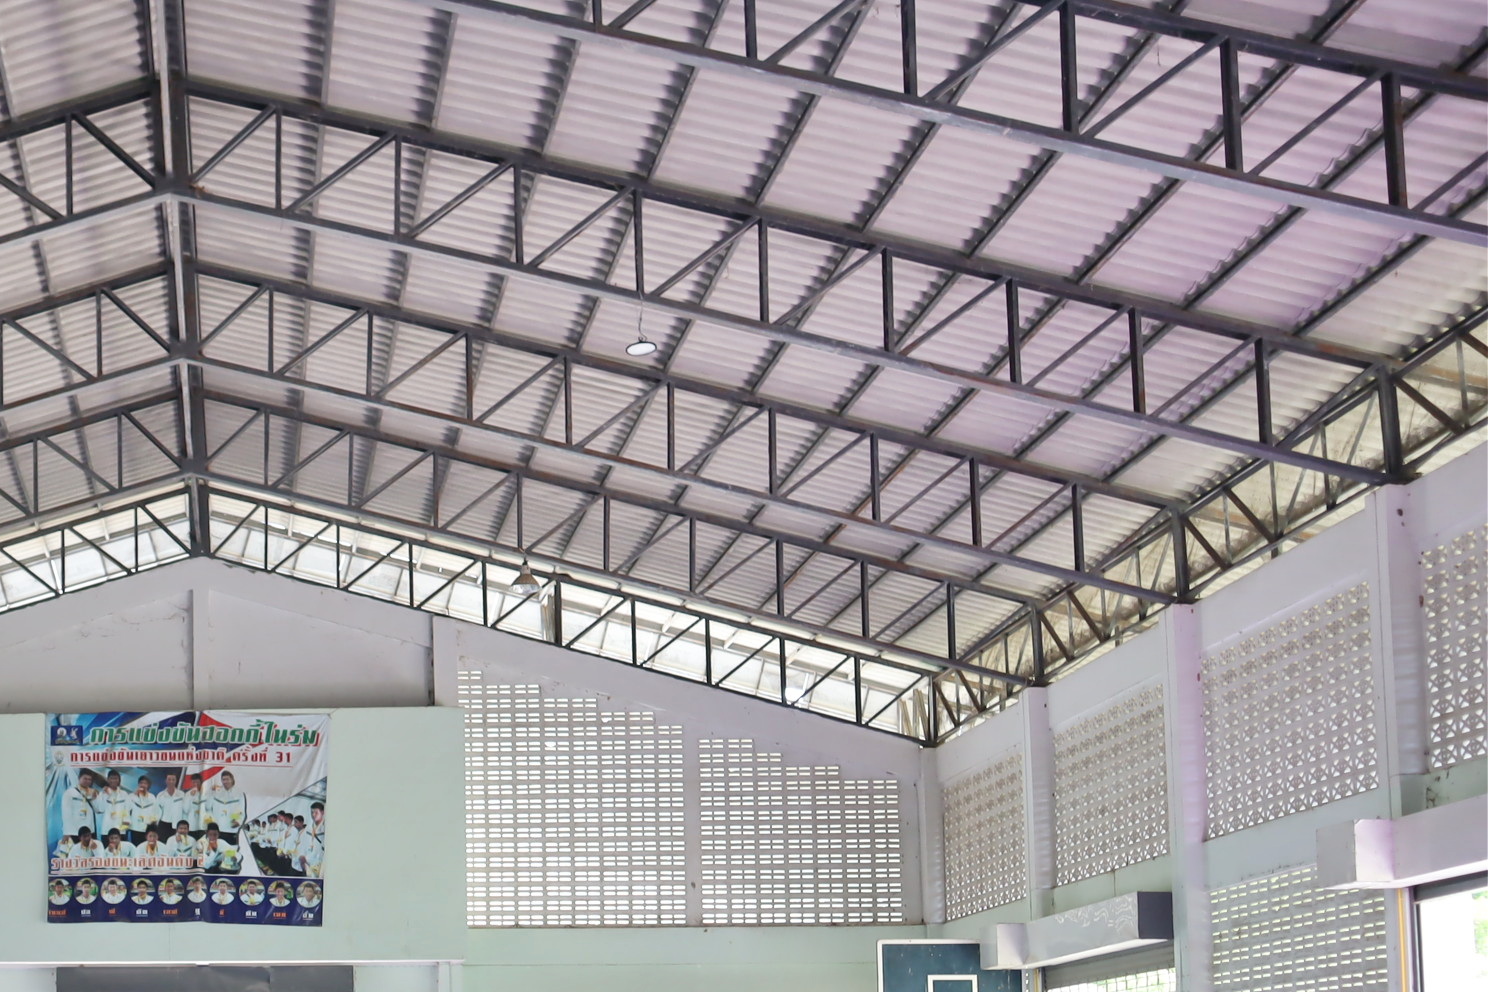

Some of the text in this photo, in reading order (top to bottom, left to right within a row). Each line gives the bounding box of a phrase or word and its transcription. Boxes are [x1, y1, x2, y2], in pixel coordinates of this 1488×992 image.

[89, 719, 318, 746] การแข่งขันฮอกกี้ในร่ม
[70, 746, 292, 763] การแข่งขันเยาวชนแห่งชาติ ครั้งที่ 31
